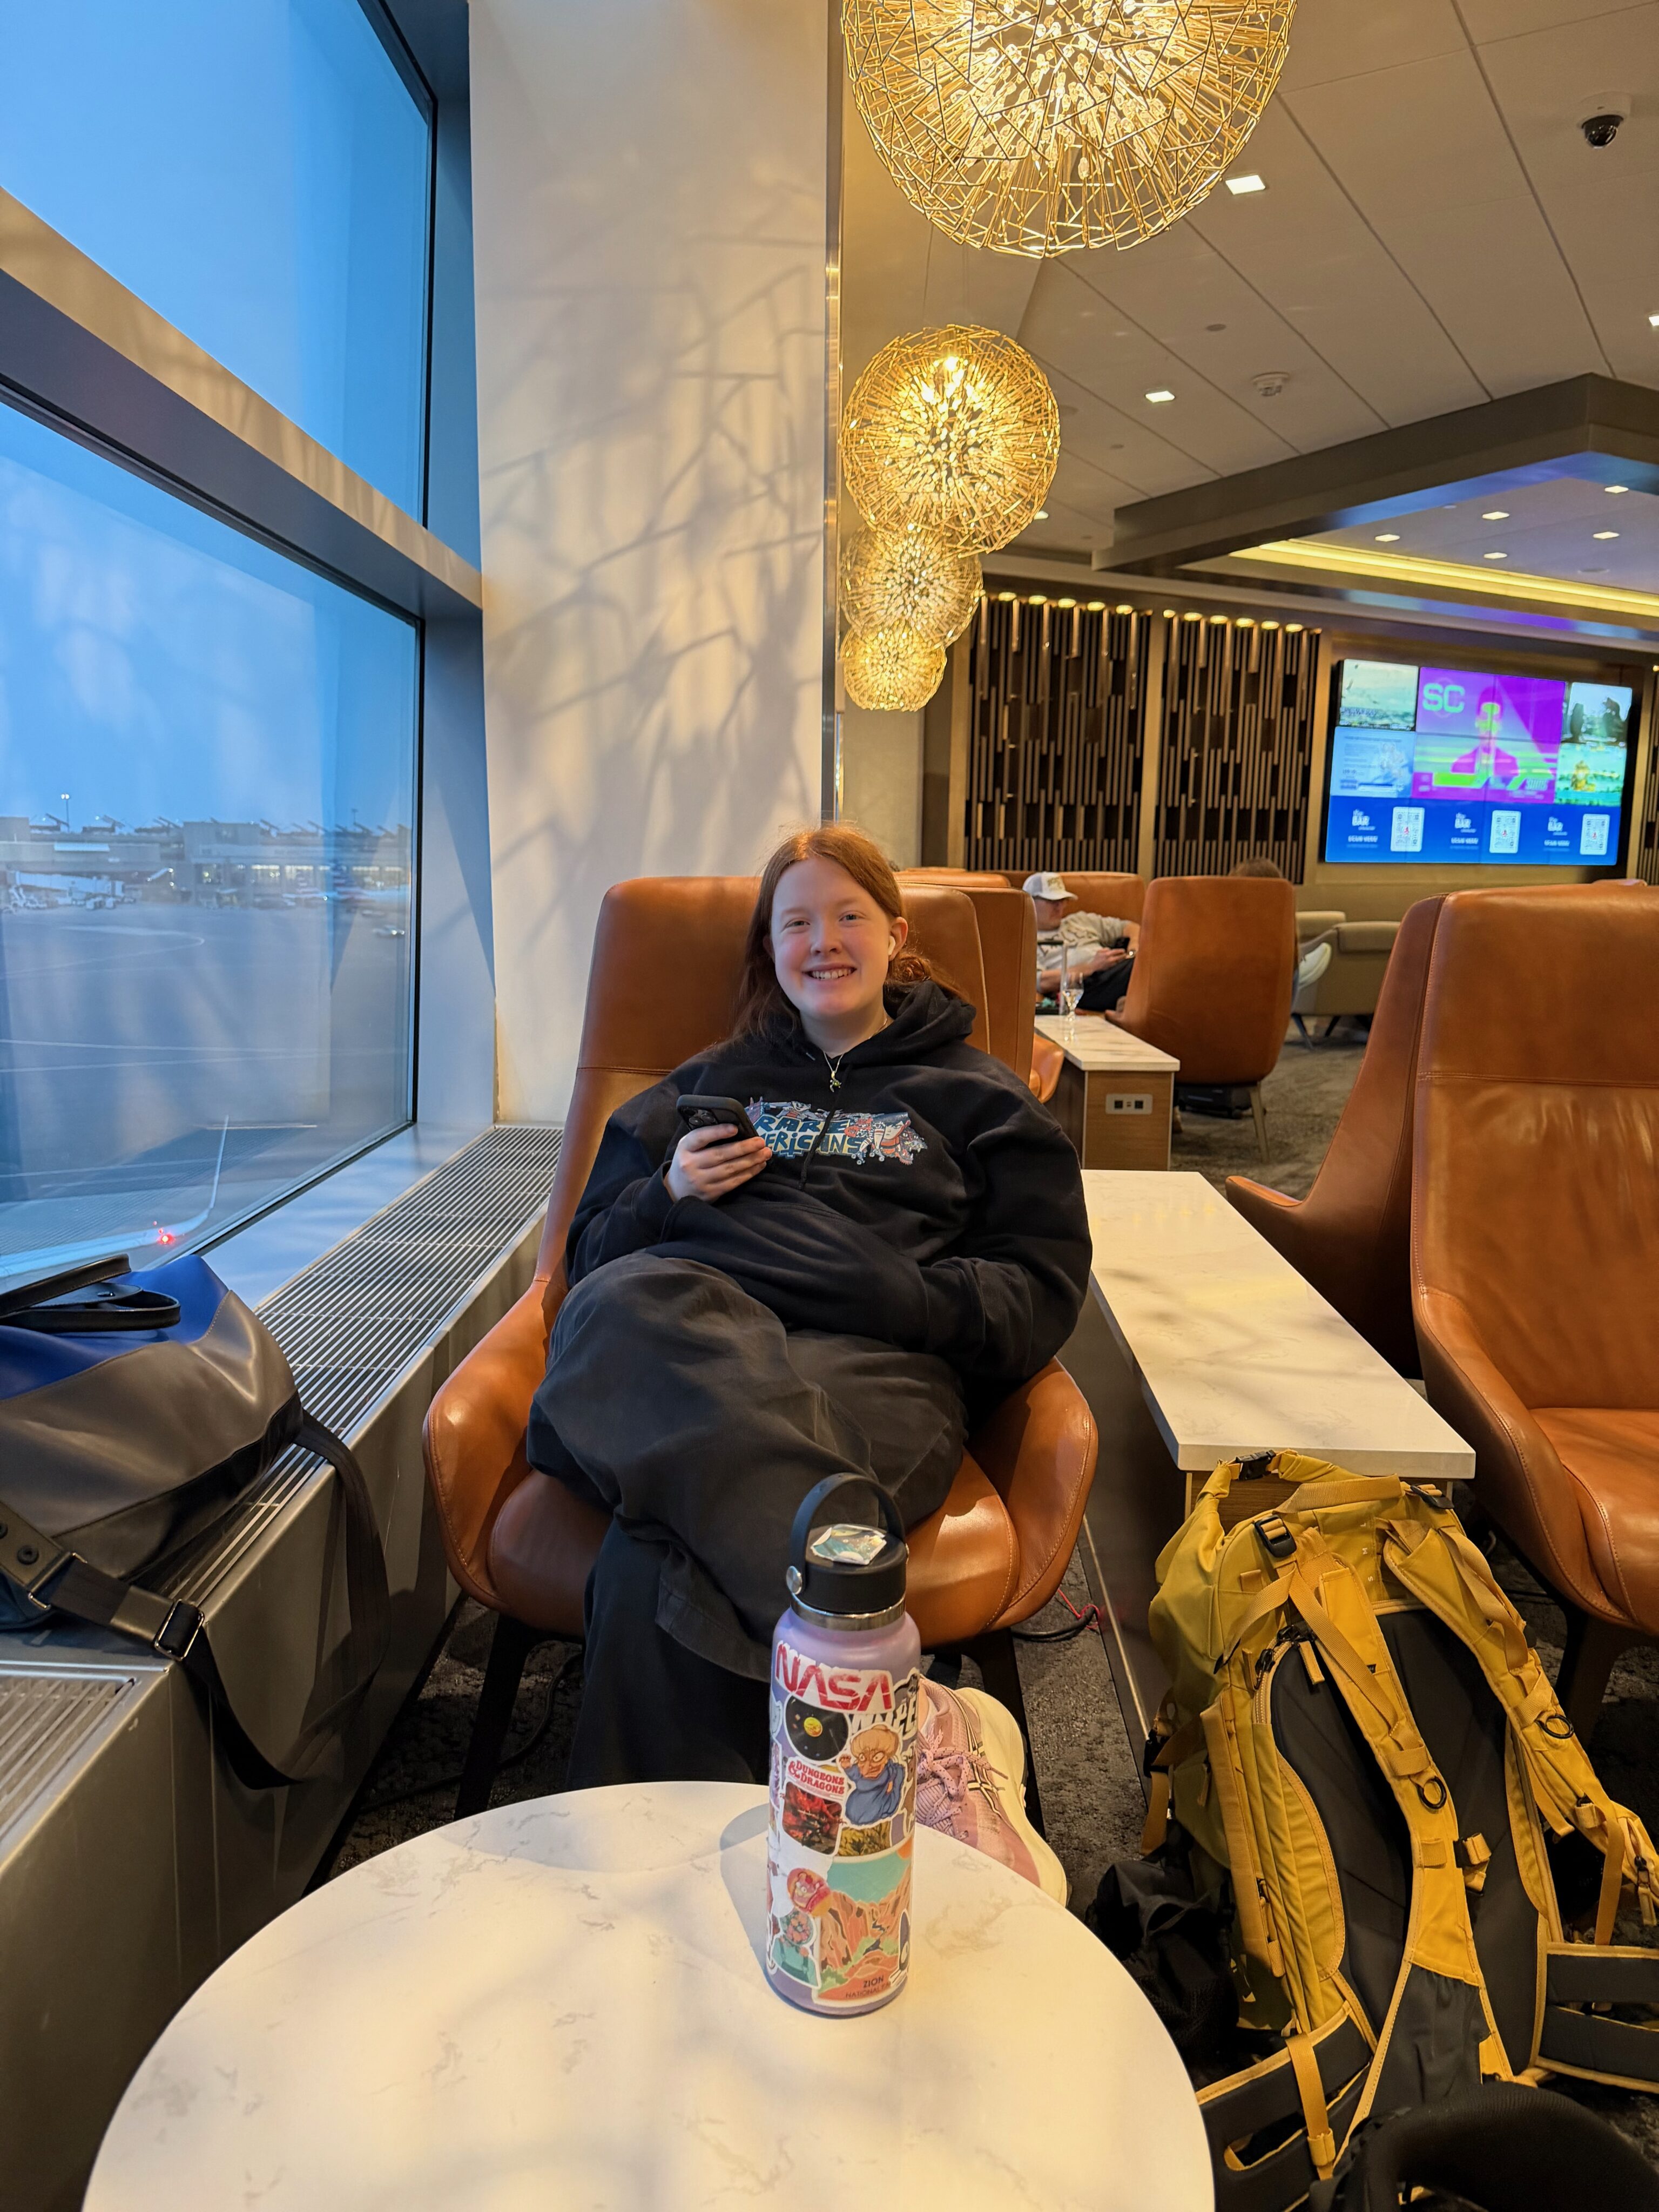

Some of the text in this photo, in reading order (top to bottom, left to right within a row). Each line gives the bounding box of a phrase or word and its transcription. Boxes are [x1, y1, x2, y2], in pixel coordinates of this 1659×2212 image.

[1422, 683, 1465, 713] SC
[756, 1116, 849, 1134] RARE
[775, 1643, 892, 1711] NASA
[796, 1759, 845, 1785] DUNGEONS
[800, 1772, 845, 1795] DRAGONS
[846, 1986, 880, 1998] NATIONAL
[863, 1975, 884, 1988] ZION
